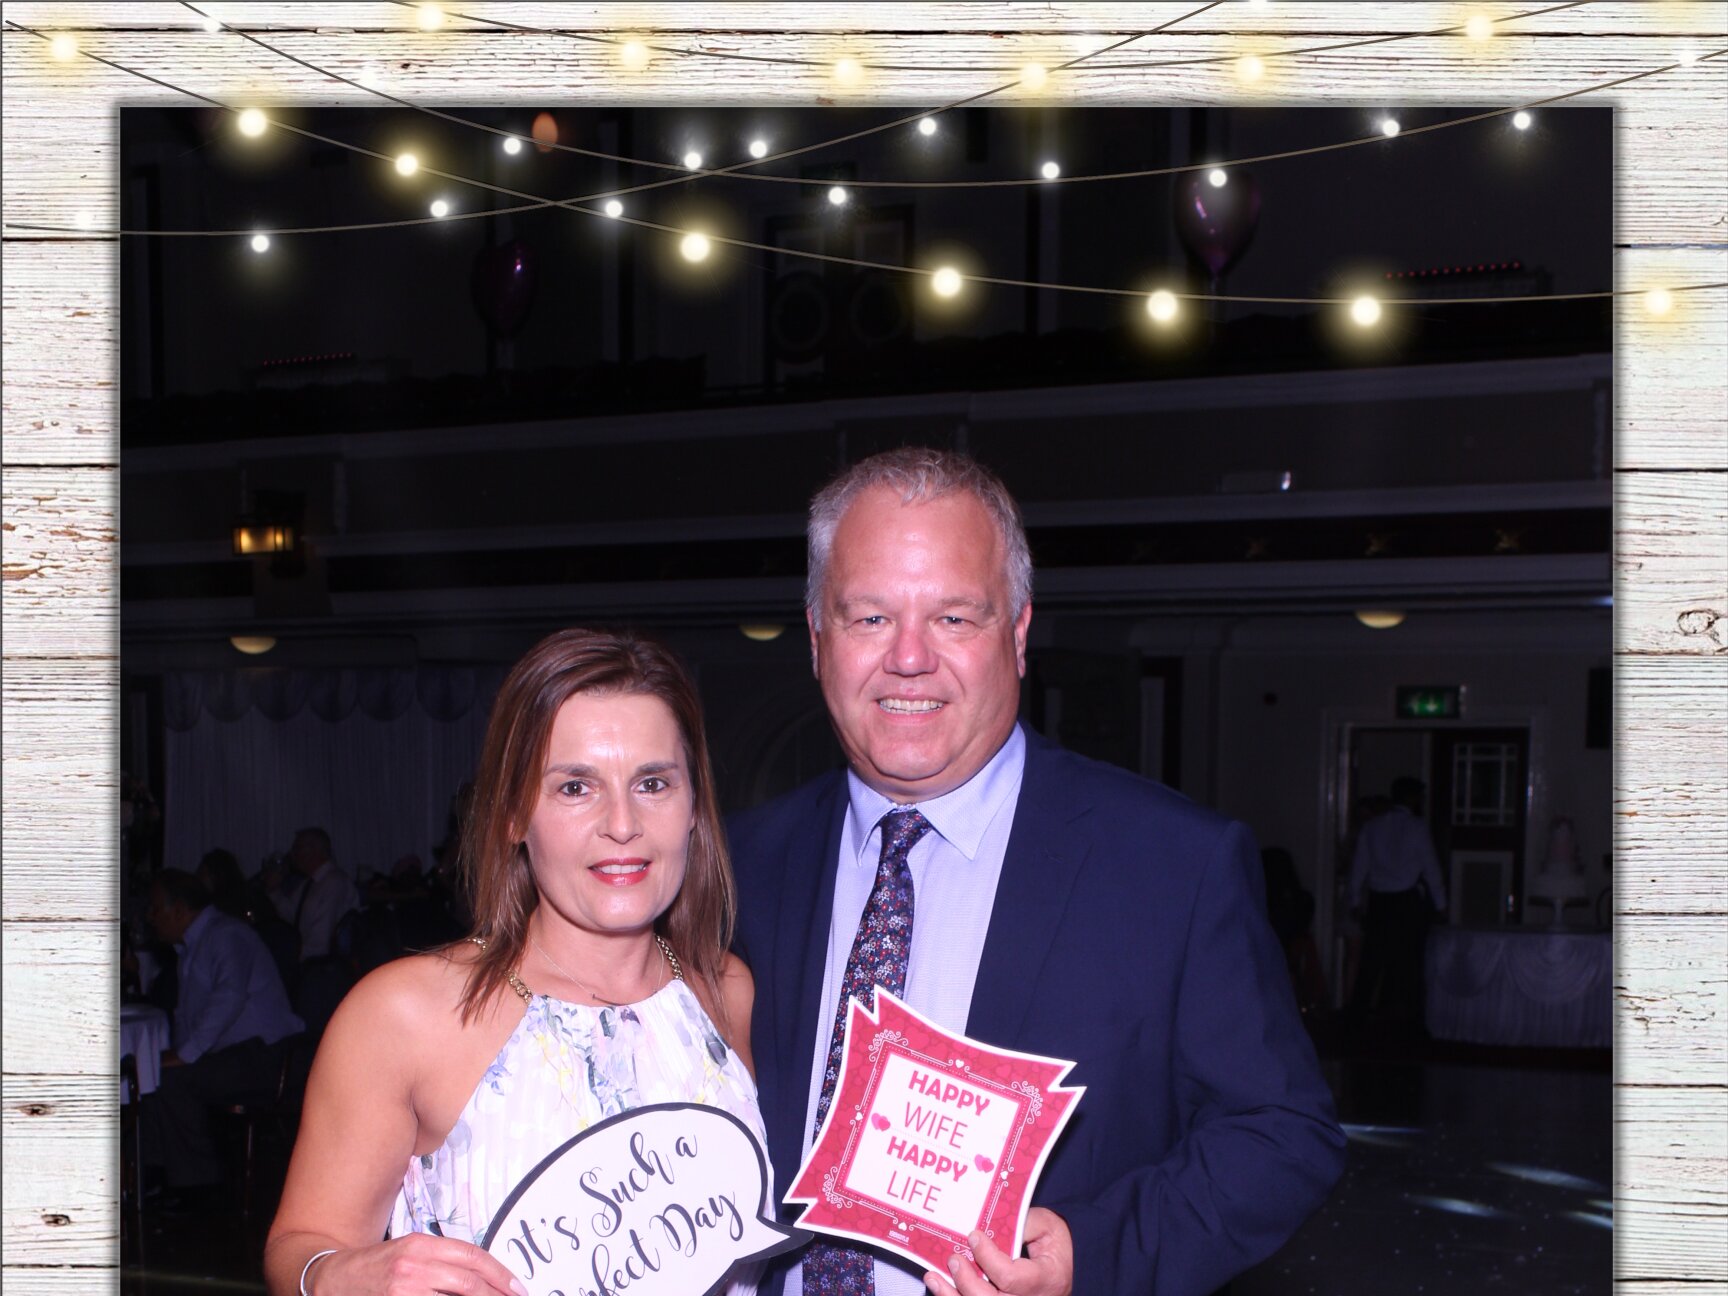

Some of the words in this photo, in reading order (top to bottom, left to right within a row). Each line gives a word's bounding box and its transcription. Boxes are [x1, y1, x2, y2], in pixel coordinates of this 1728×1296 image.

[908, 1070, 990, 1116] HAPPY
[904, 1101, 968, 1149] WIFE
[886, 1136, 968, 1182] HAPPY
[507, 1216, 580, 1280] It's
[579, 1132, 674, 1237] Such
[675, 1135, 698, 1158] a
[887, 1170, 942, 1213] LIFE
[649, 1192, 743, 1257] Day
